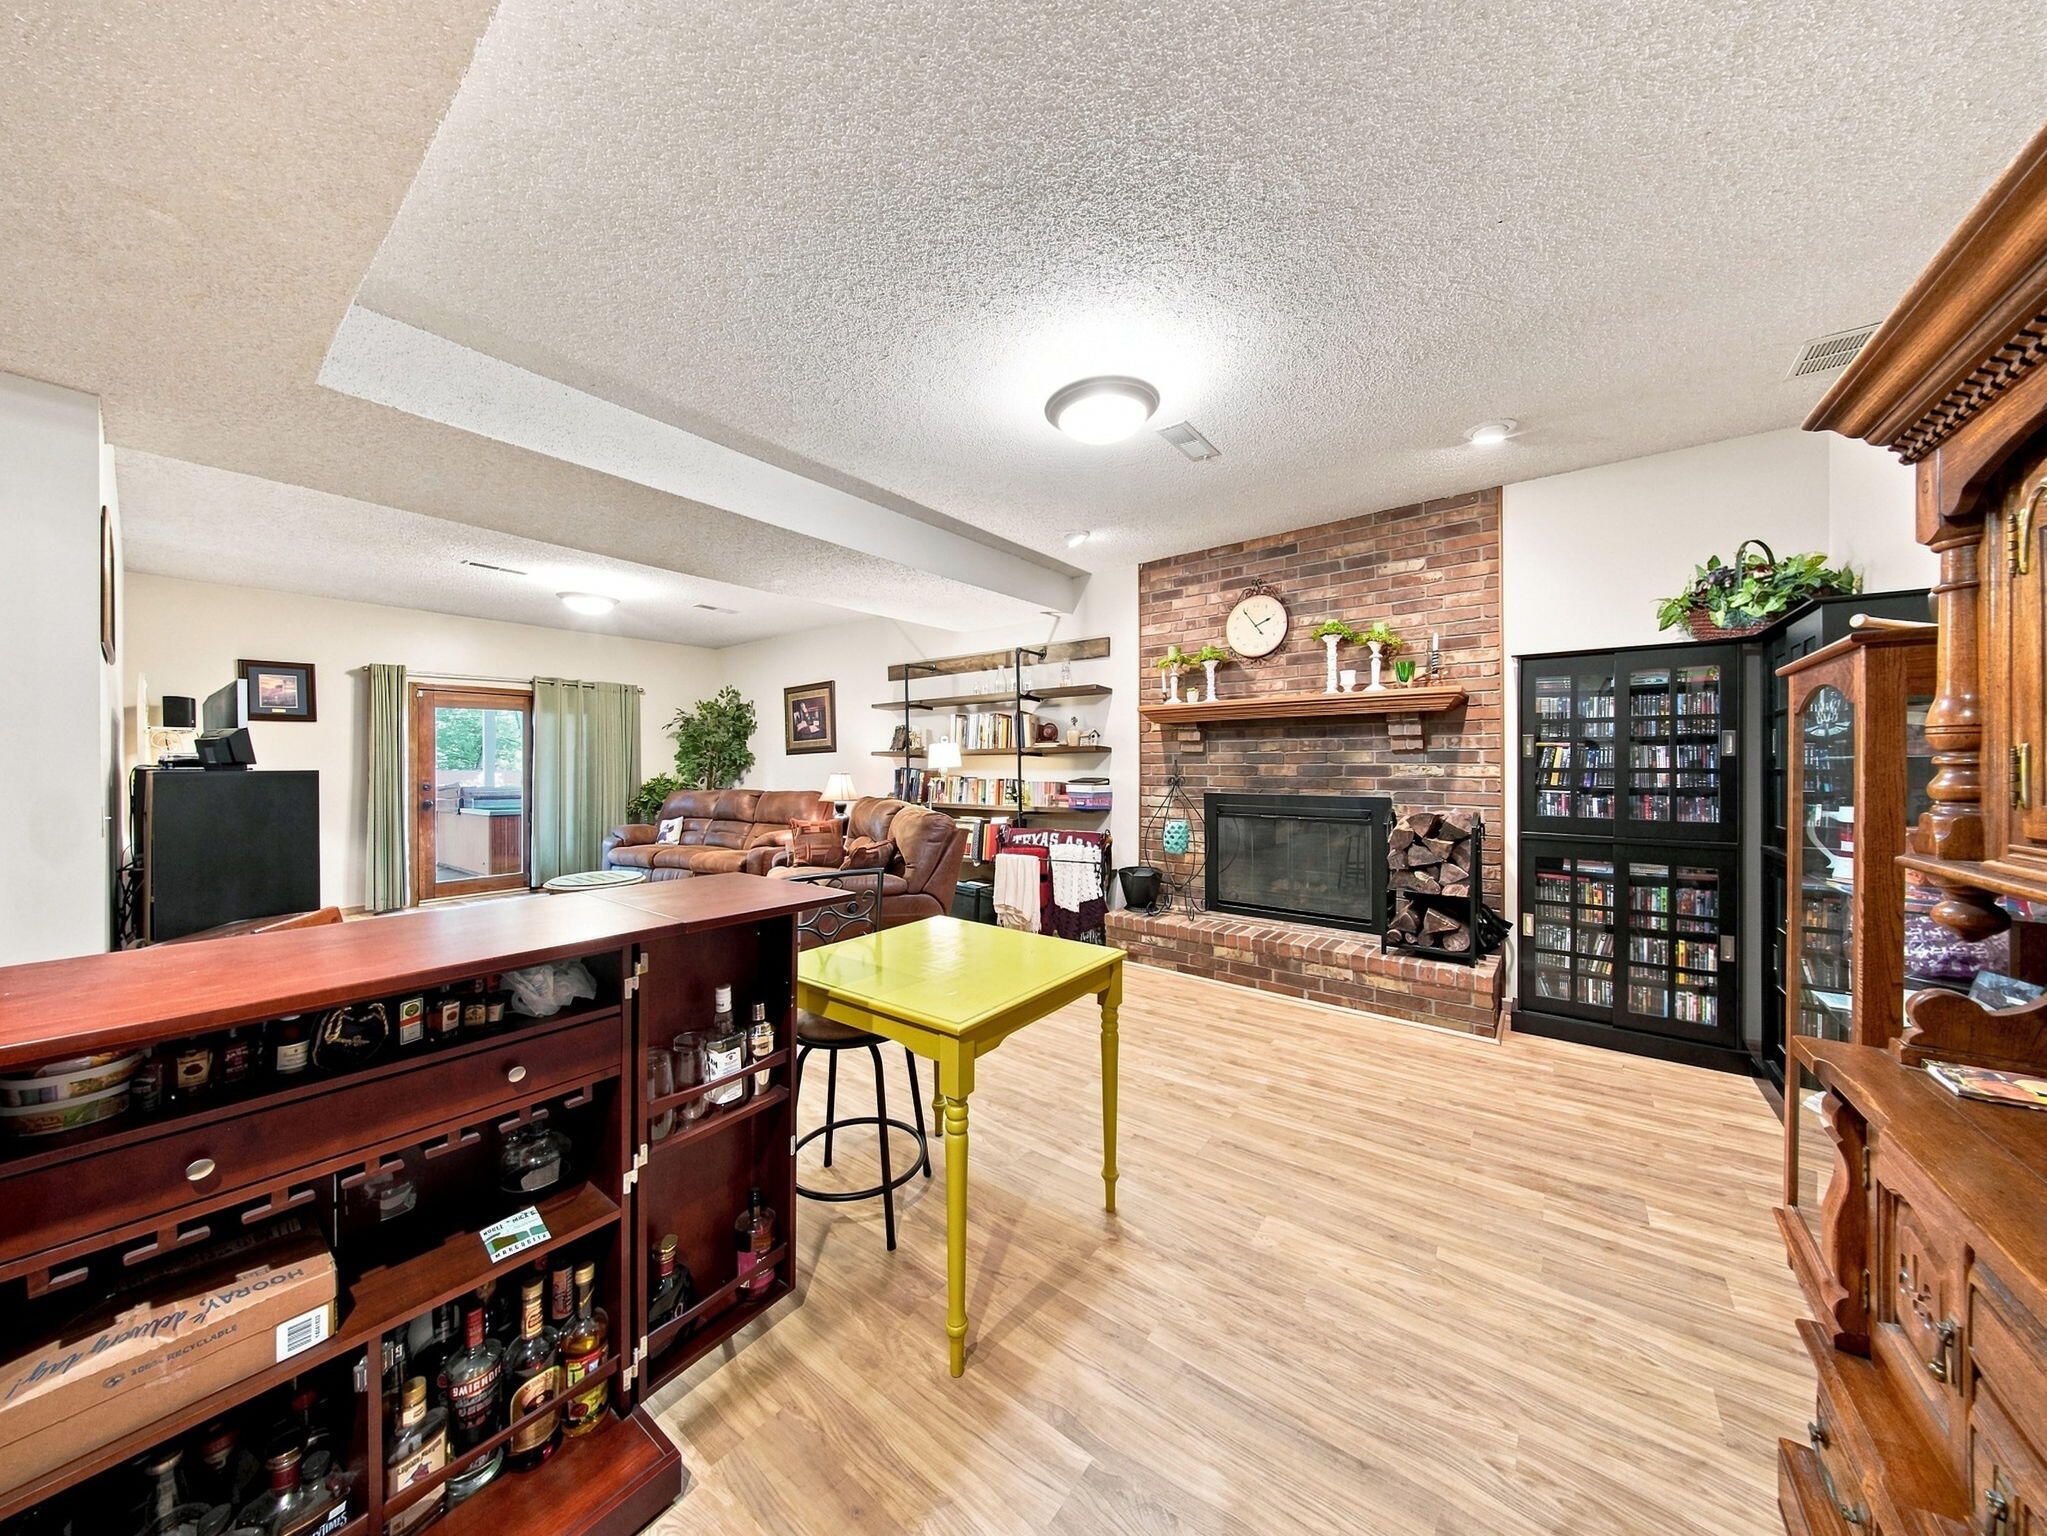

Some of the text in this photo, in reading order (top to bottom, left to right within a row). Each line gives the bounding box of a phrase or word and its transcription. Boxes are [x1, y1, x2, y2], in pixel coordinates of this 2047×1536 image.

[1012, 831, 1060, 847] TEXAS
[91, 1310, 188, 1353] delivery
[166, 1324, 238, 1361] RECYCLABLE
